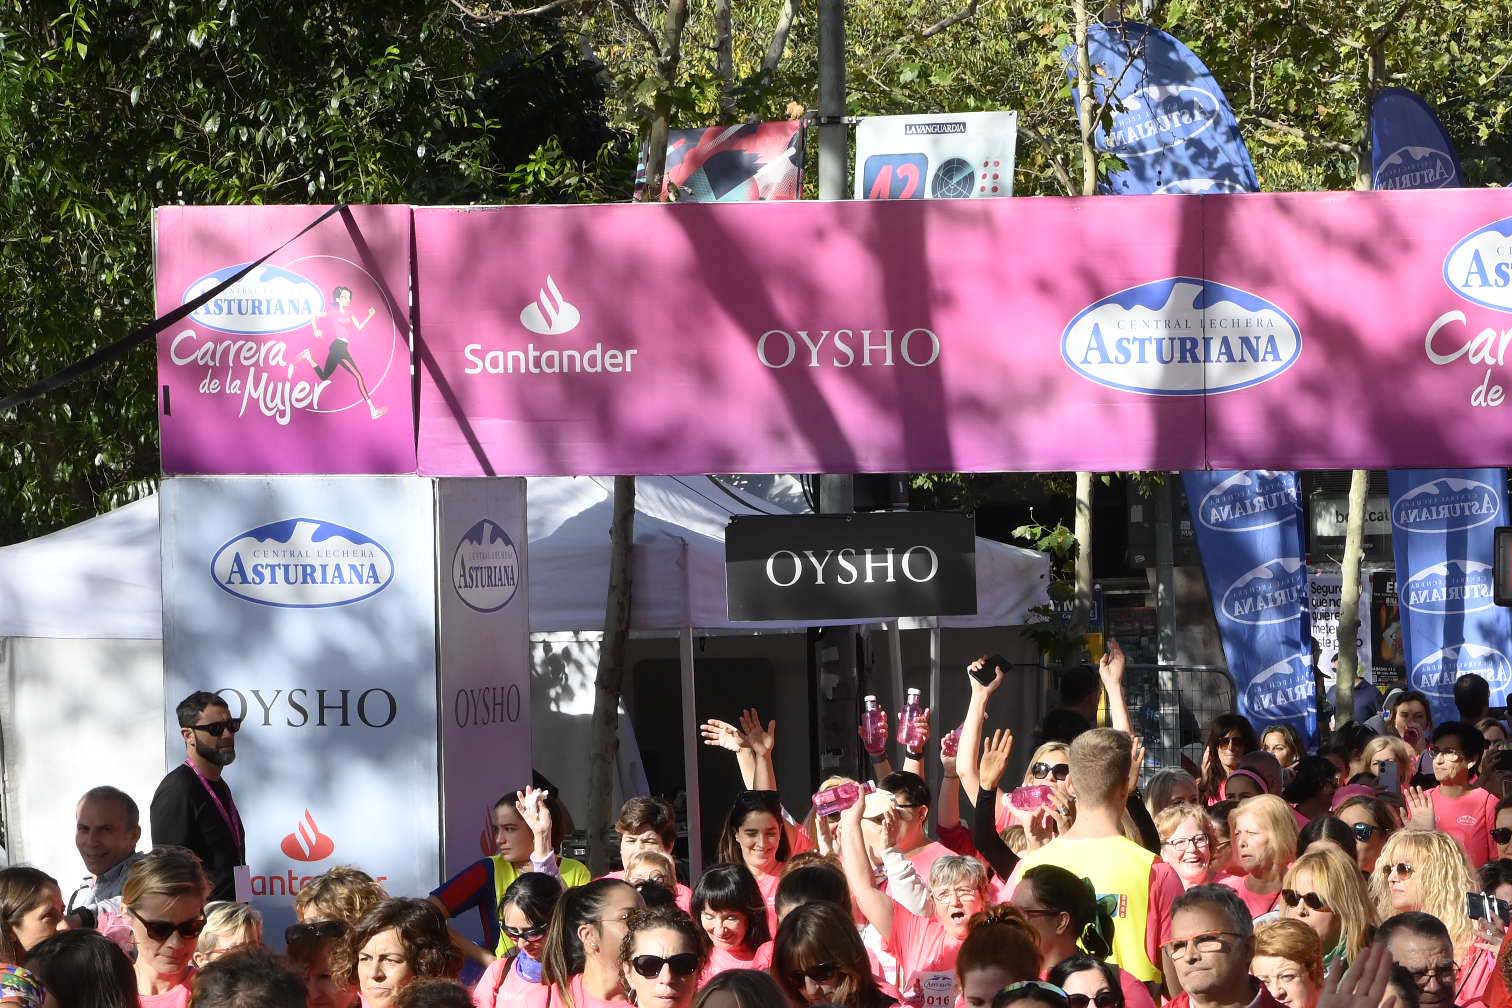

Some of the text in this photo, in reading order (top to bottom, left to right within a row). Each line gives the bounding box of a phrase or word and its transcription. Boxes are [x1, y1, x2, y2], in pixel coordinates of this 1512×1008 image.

[1116, 317, 1275, 329] CENTRAL LECHERA
[170, 329, 289, 367] Carrera
[464, 343, 638, 375] Santander
[756, 328, 940, 368] OYSHO
[1080, 322, 1283, 365] ASTURIANA
[199, 364, 332, 426] de la Mujer
[1470, 369, 1506, 407] de
[225, 551, 381, 585] ASTURIANA
[253, 549, 376, 558] CENTRAL LECHERA
[457, 553, 516, 590] ASTURIANA
[766, 545, 939, 587] OYSHO
[454, 683, 522, 729] OYSHO
[927, 996, 949, 1005] 016
